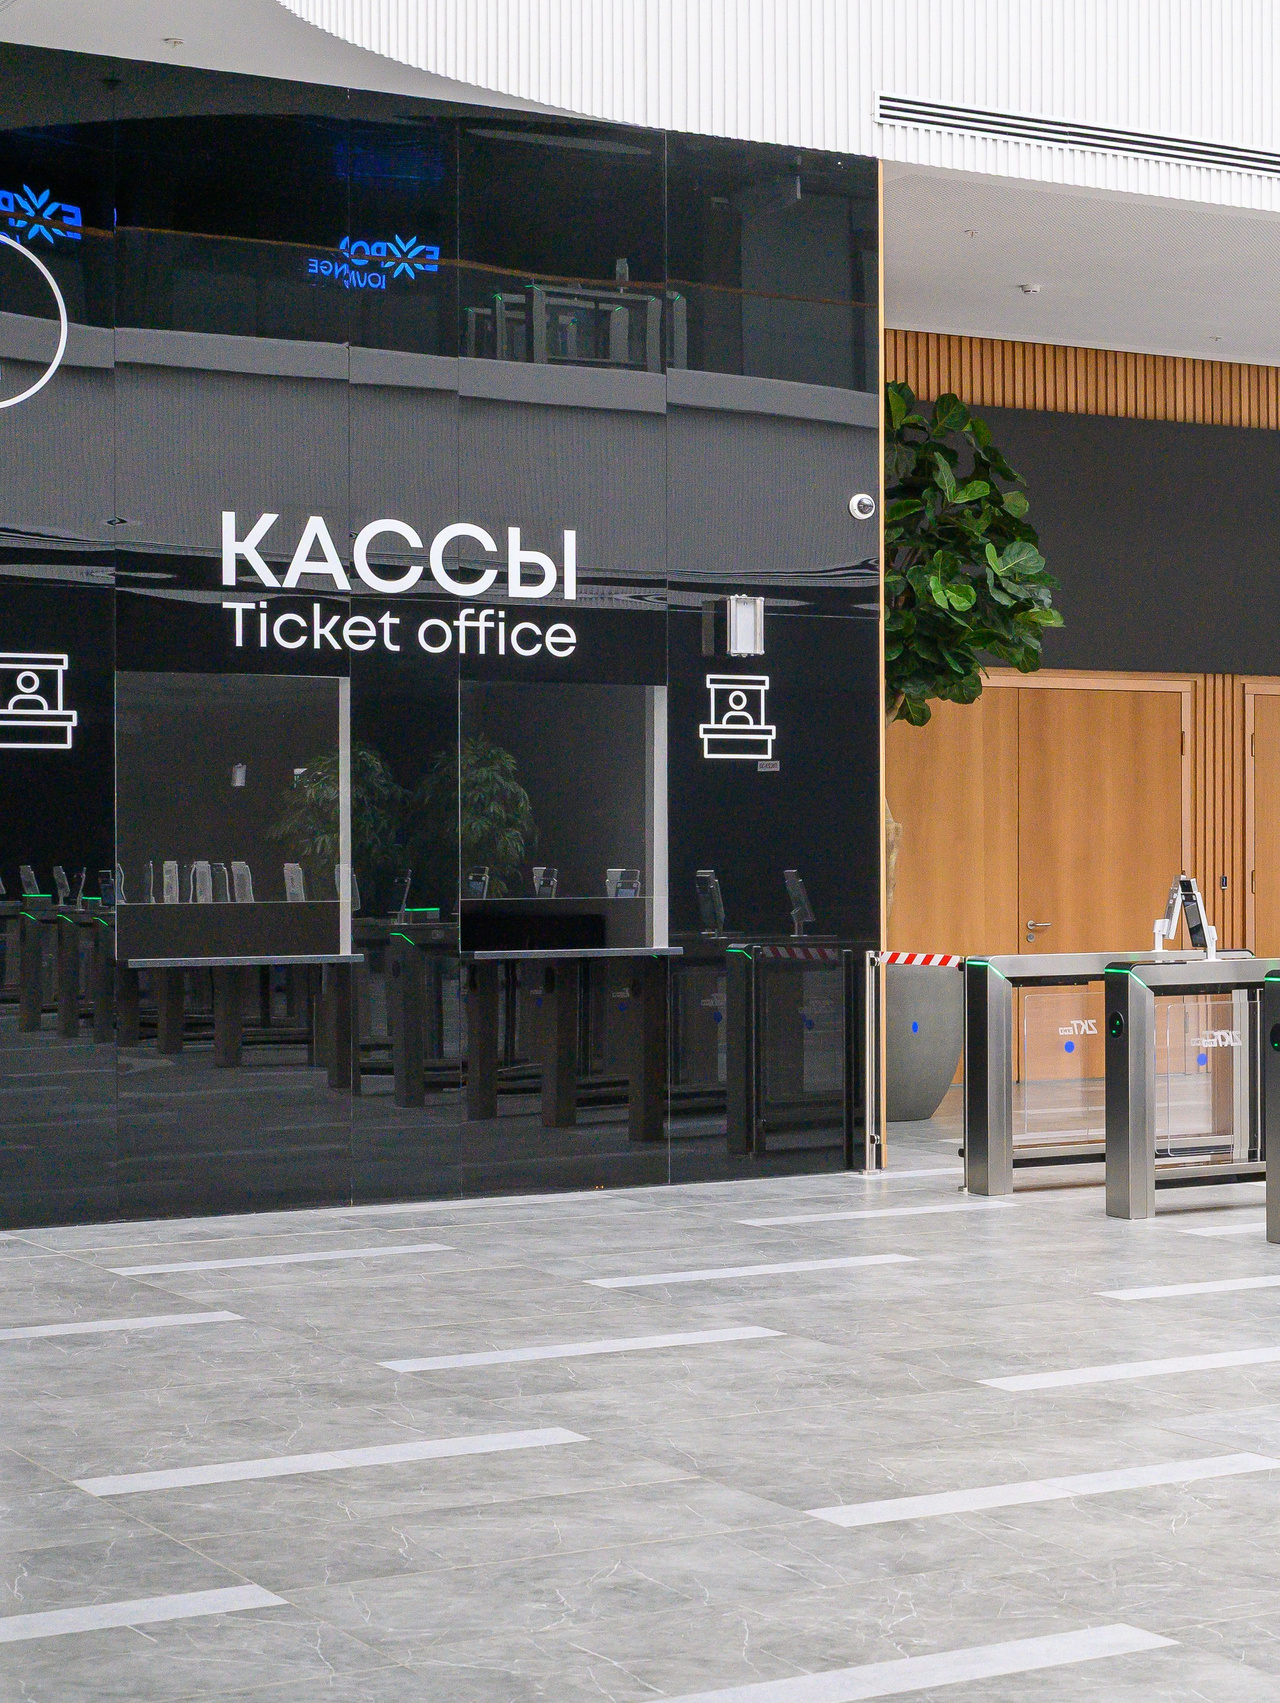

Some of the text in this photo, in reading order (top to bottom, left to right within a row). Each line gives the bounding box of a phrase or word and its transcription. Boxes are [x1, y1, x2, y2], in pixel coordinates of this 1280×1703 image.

[222, 511, 577, 600] КАССЫ
[222, 601, 577, 657] Ticket office
